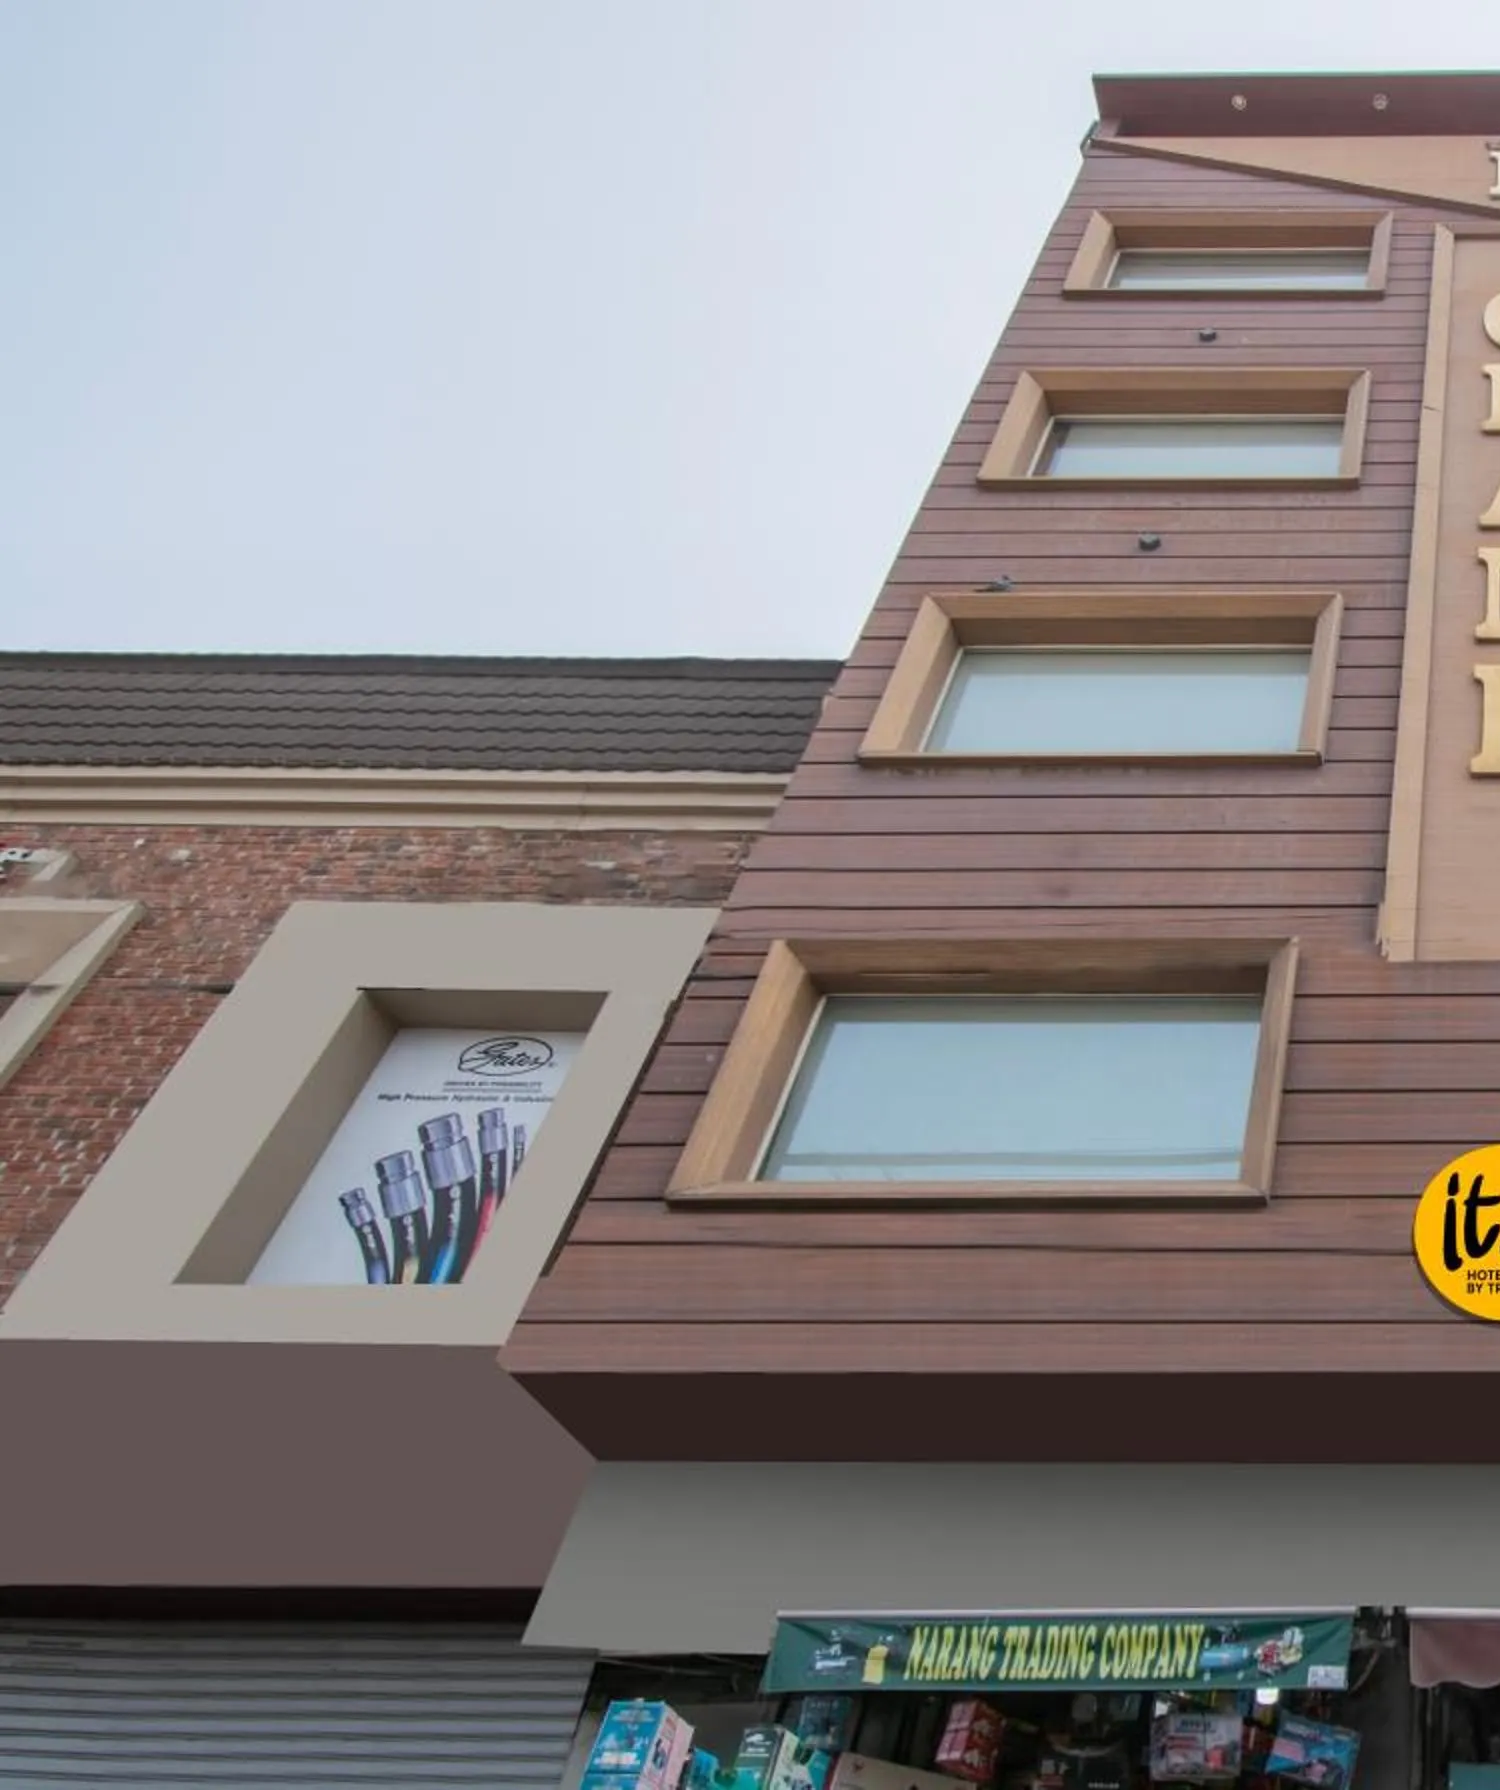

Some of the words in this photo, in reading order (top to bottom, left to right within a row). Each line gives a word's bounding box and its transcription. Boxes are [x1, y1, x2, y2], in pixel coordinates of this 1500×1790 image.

[1467, 1283, 1483, 1294] BY
[903, 1625, 999, 1681] NARANG
[998, 1624, 1098, 1680] TRADING
[1098, 1623, 1204, 1680] COMPANY
